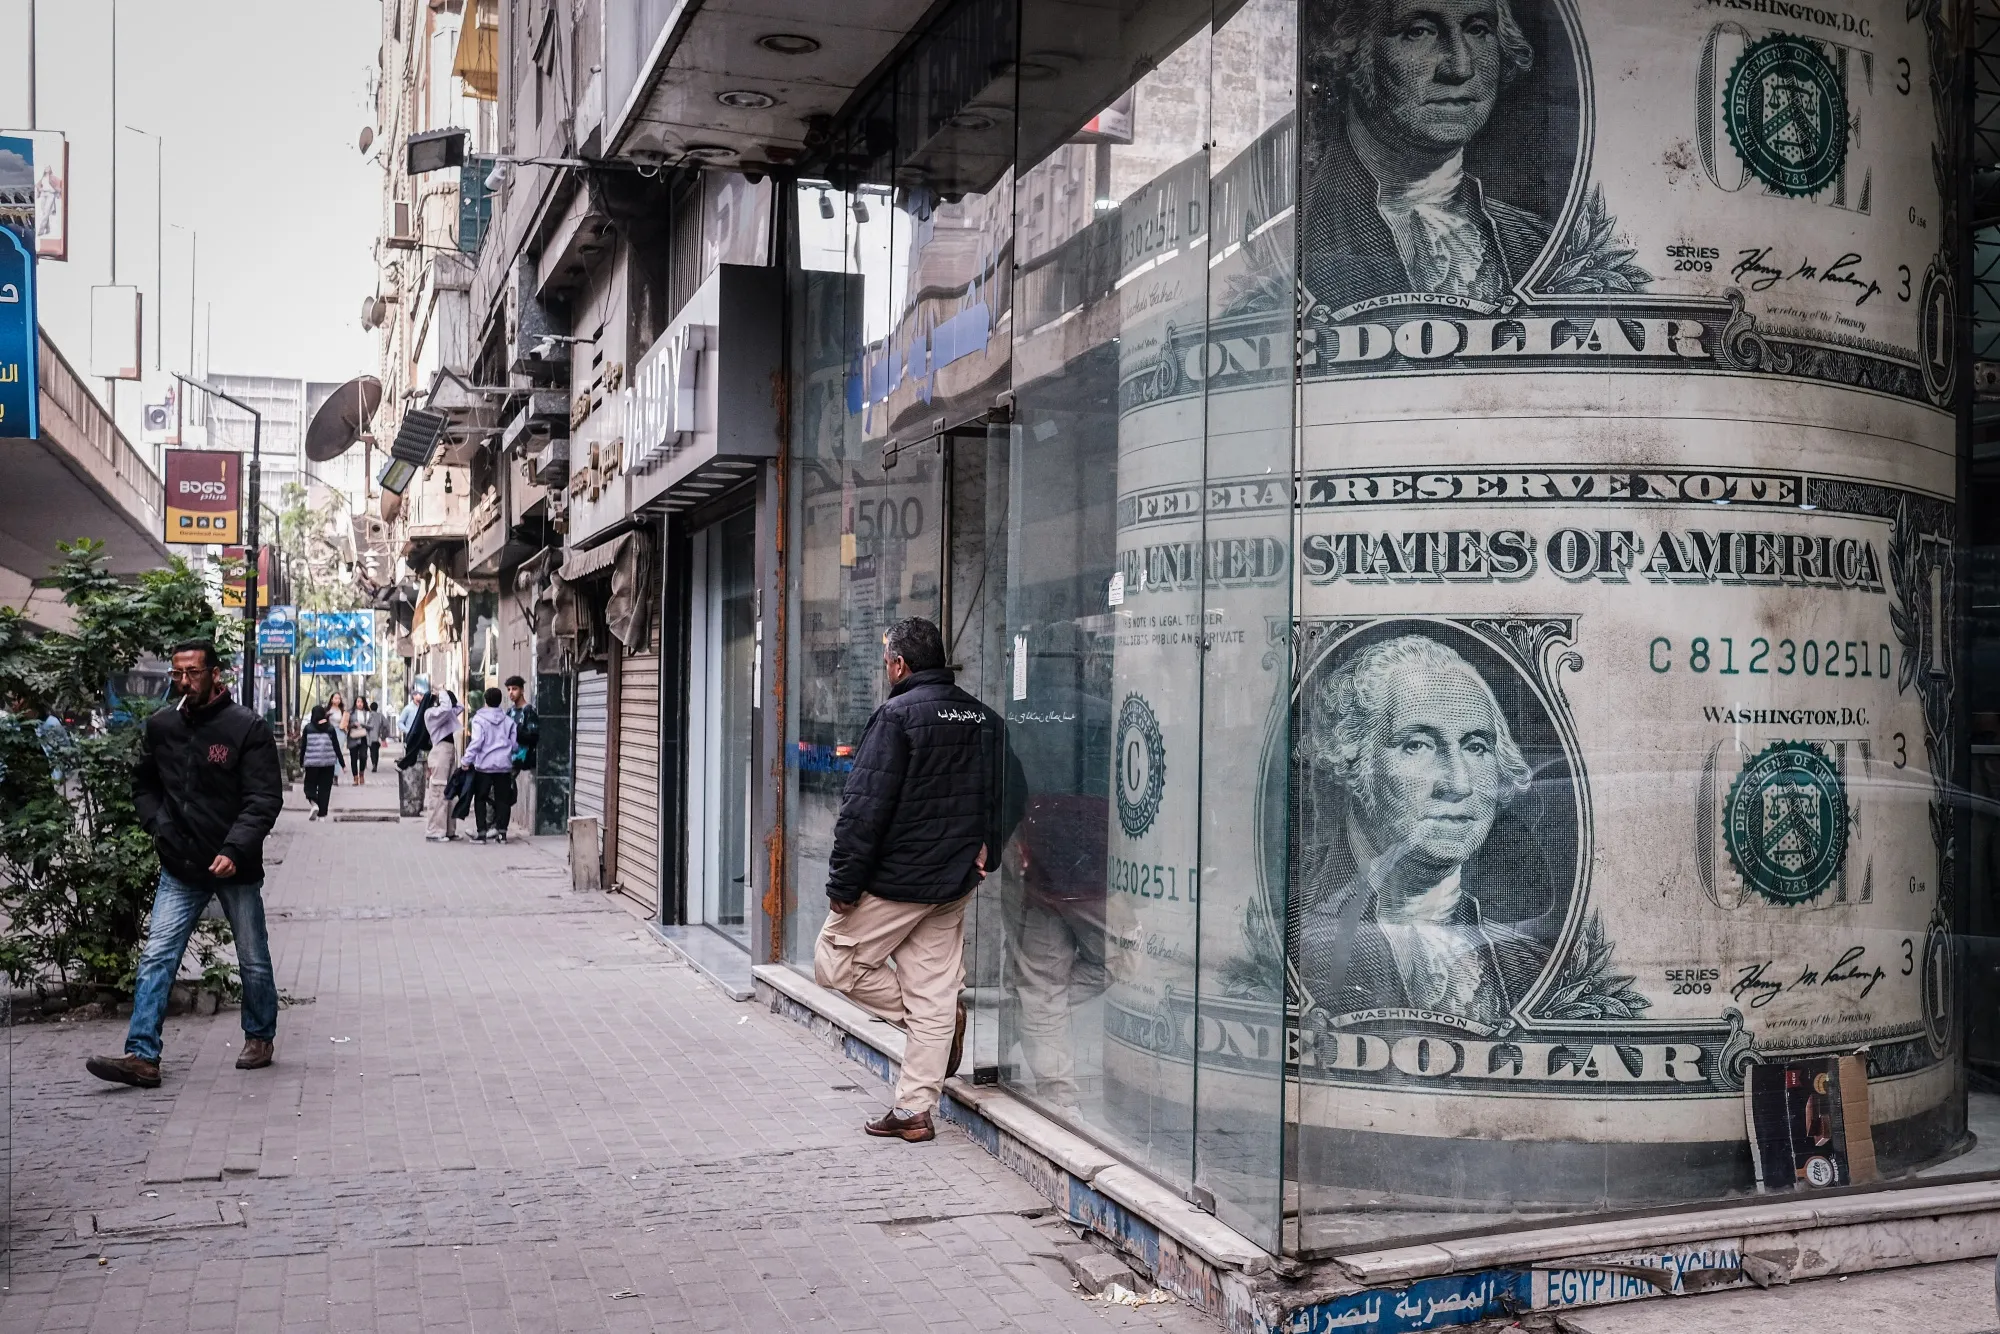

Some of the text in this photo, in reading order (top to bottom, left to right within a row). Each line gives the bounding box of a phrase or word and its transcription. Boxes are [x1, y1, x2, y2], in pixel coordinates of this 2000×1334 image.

[1736, 47, 1787, 115] DEPARTMEN
[1794, 48, 1811, 63] OF
[1897, 57, 1911, 95] 3
[1779, 170, 1808, 185] 1789
[1666, 245, 1720, 260] SERIES
[1674, 259, 1713, 273] 2009
[1897, 265, 1912, 302] 3
[1352, 293, 1471, 312] WASHINGTON
[1185, 318, 1712, 382] ONE DOLLAR
[622, 325, 686, 476] DANDY
[180, 480, 226, 494] BOGO
[200, 493, 227, 501] plus
[1139, 474, 1796, 520] FEDERAL RESERVE NOTE
[858, 496, 924, 541] 500
[1144, 537, 1288, 592] UNITED
[1301, 528, 1536, 585] STATES
[1545, 528, 1644, 584] OF
[1641, 530, 1888, 594] AMERICA
[1152, 633, 1178, 645] PUBLIC
[1160, 615, 1183, 627] LEGAL
[1649, 636, 1672, 673] C
[1127, 741, 1141, 791] C
[1893, 732, 1907, 770] 3
[1736, 755, 1787, 831] DEPARTMEN
[1794, 754, 1811, 768] OF
[1779, 879, 1808, 892] 1789
[1665, 968, 1720, 982] SERIES
[1901, 938, 1914, 976] 3
[1673, 982, 1712, 995] 2009
[1351, 1009, 1468, 1028] WASHINGTON
[1183, 1014, 1707, 1082] ONE DOLLAR
[1281, 1280, 1495, 1334] المصرية للصراف
